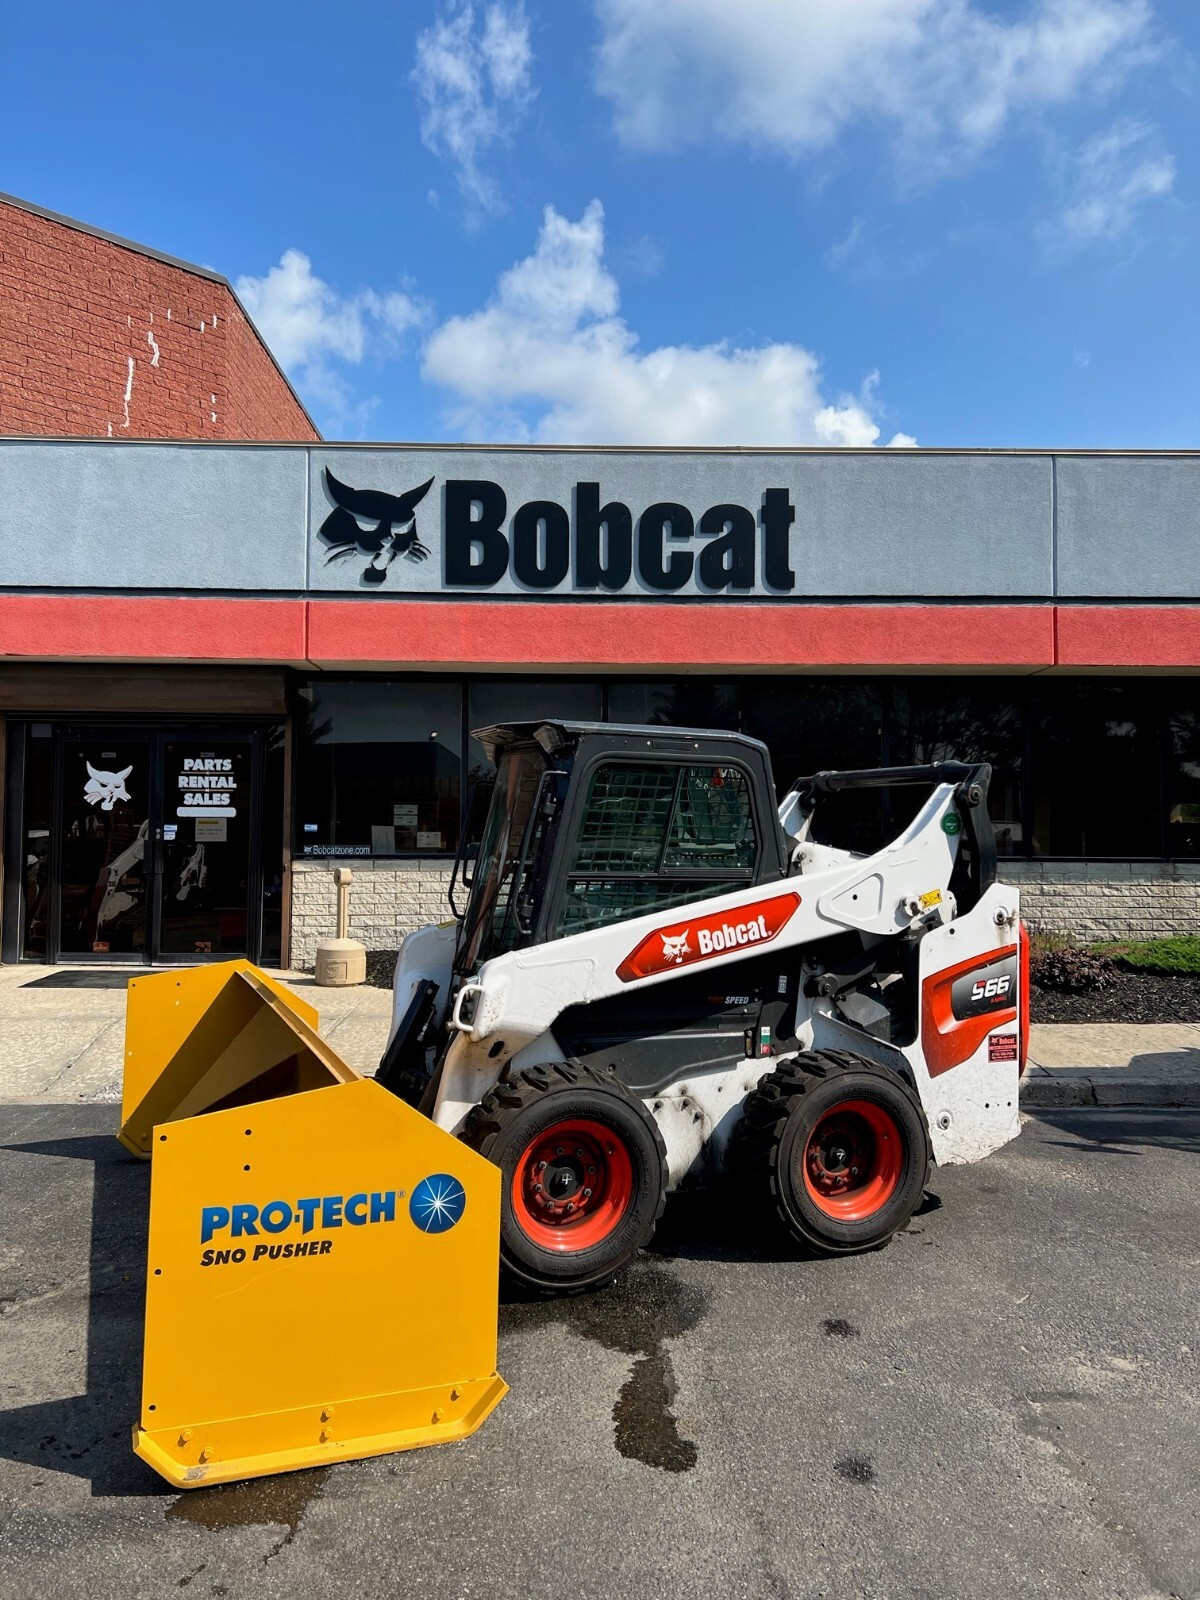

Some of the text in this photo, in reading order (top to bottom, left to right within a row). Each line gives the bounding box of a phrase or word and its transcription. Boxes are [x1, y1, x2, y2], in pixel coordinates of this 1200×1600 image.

[445, 479, 796, 591] Bobcat
[183, 758, 232, 771] PARTS
[178, 776, 238, 789] RENTAL
[183, 793, 231, 806] SALES
[312, 845, 371, 855] Bobcatzone.com
[697, 914, 768, 955] Bobcat
[971, 974, 1011, 1001] S66
[724, 995, 750, 1005] SPEED
[200, 1240, 333, 1267] SNO PUSHER
